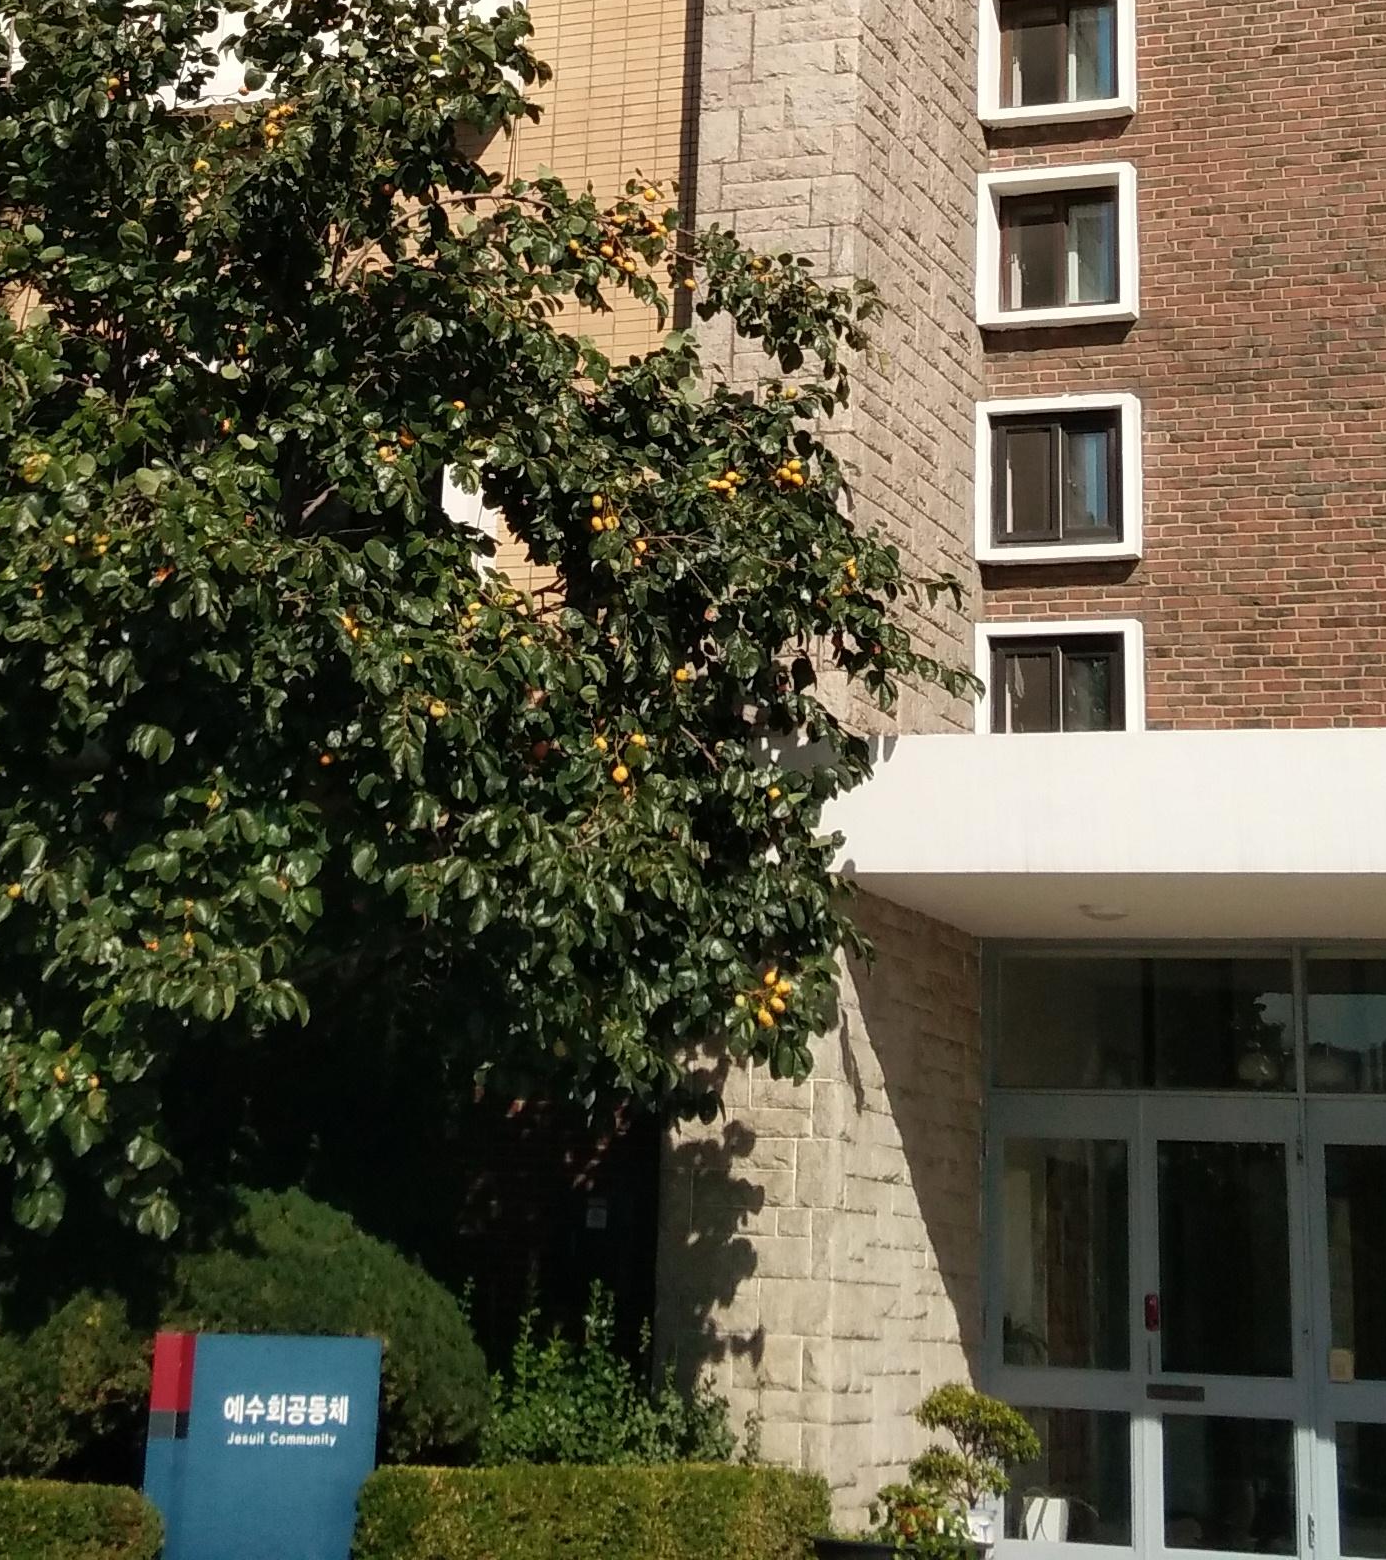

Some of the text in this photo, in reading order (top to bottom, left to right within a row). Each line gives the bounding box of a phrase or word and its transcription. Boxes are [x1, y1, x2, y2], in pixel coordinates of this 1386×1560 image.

[224, 1393, 350, 1426] 예수회공동체
[226, 1431, 337, 1448] Jesuit Community
